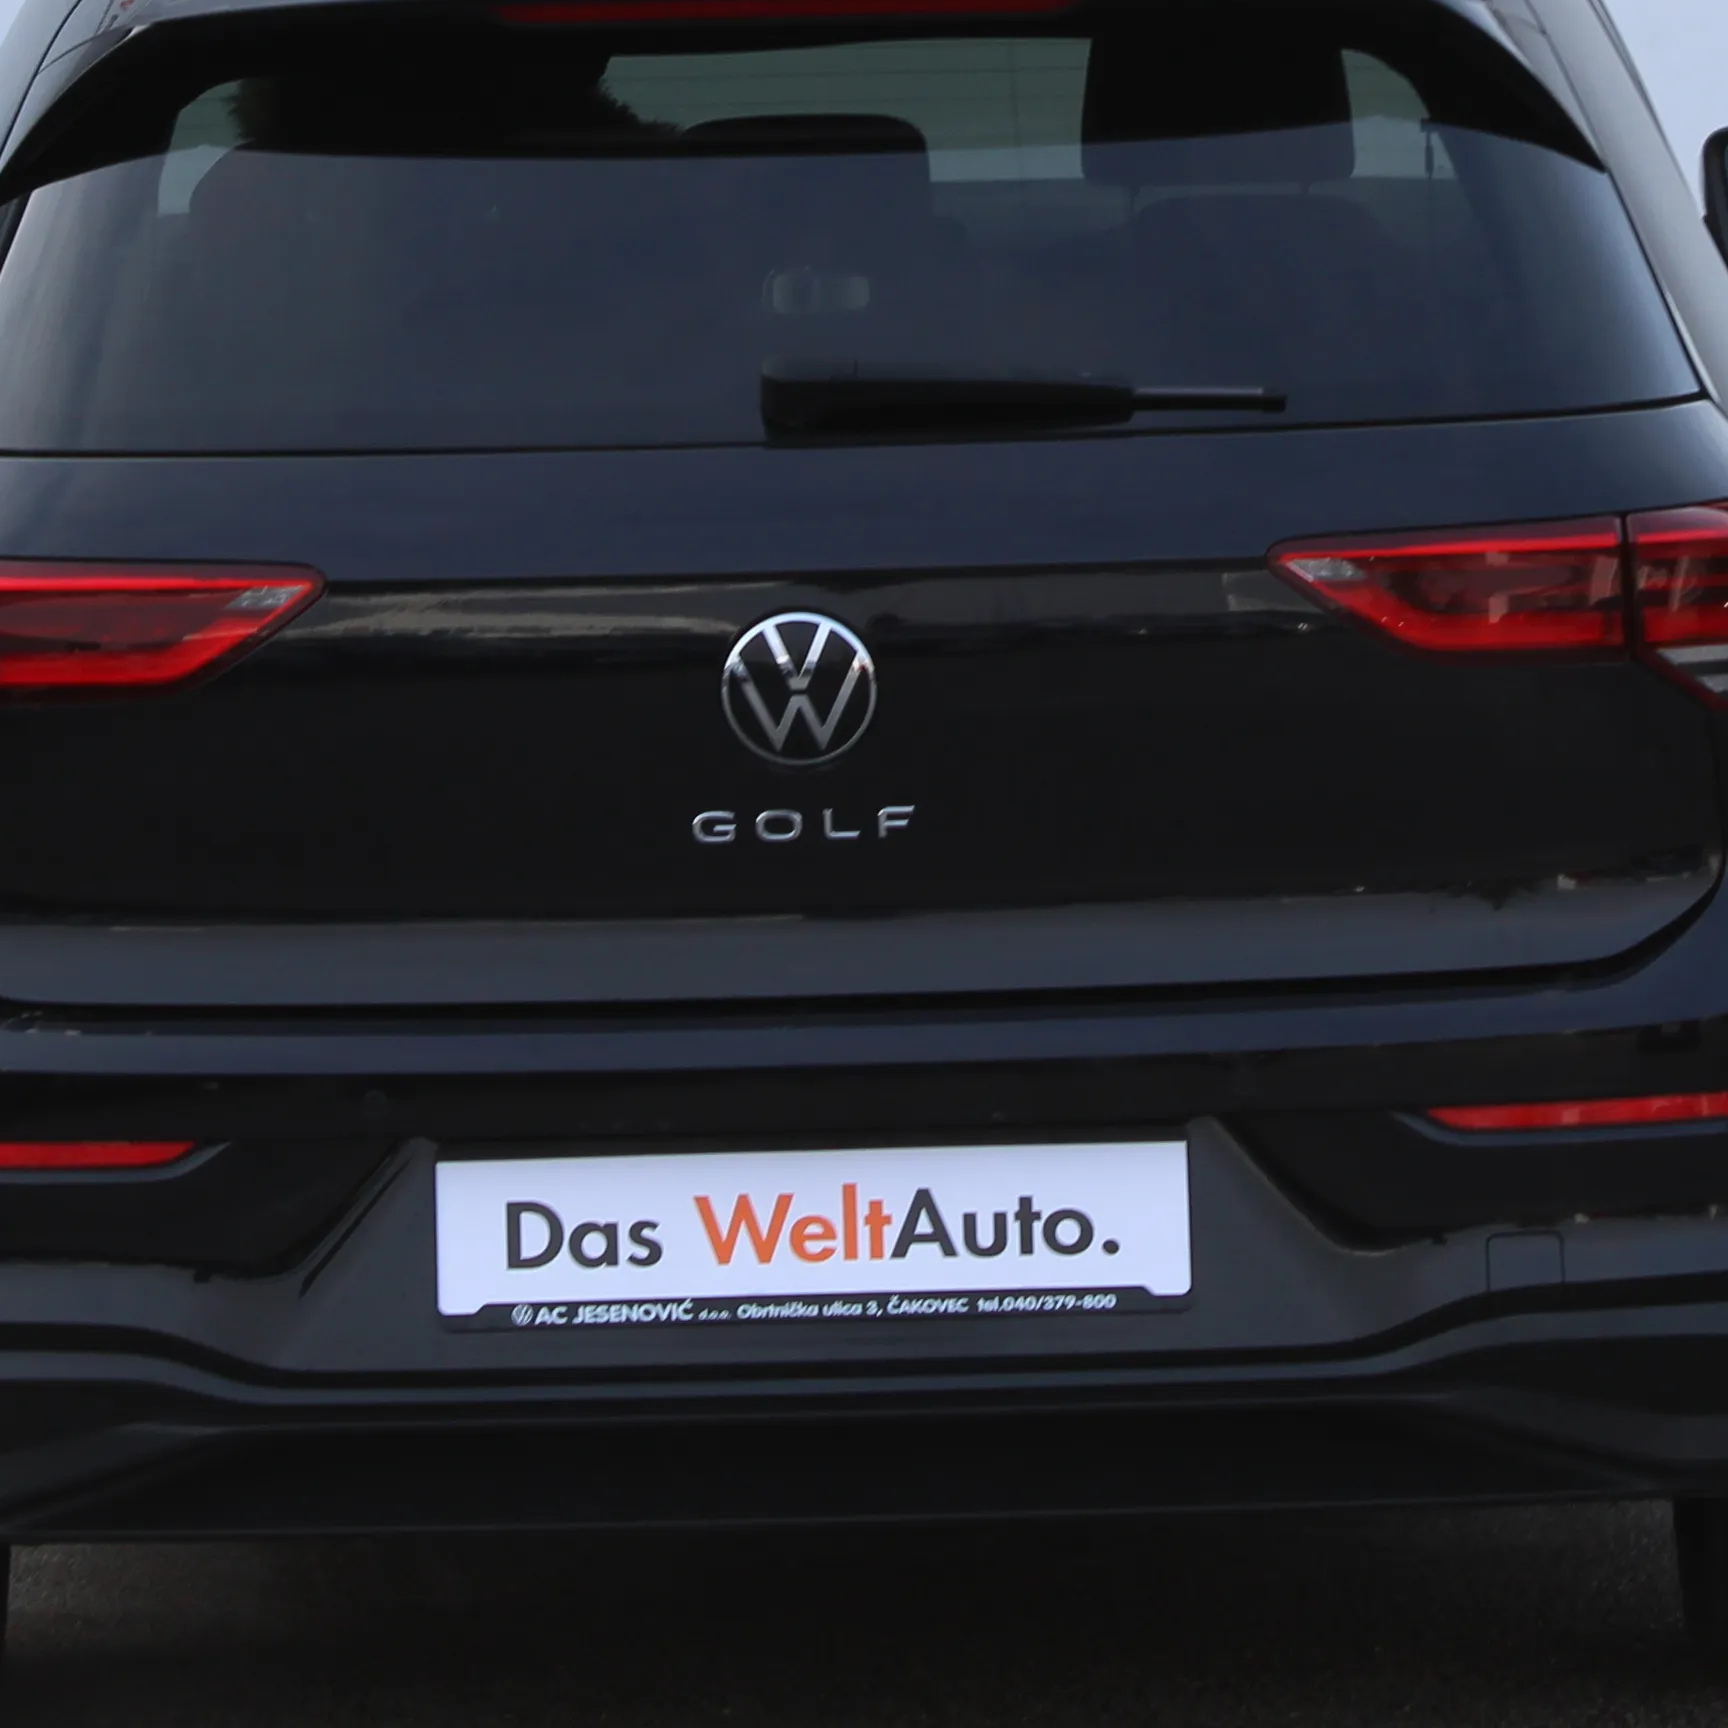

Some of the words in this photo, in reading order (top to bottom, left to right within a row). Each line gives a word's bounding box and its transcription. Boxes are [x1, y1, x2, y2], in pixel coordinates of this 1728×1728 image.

[690, 803, 917, 844] GOLF
[505, 1200, 664, 1271] Das
[693, 1183, 1121, 1266] WeltAuto.
[534, 1305, 569, 1325] AC
[572, 1297, 694, 1325] JESENOVIĆ
[736, 1300, 819, 1320] Obrtnička
[823, 1299, 863, 1318] ulica
[887, 1294, 970, 1315] ČAKOVEC
